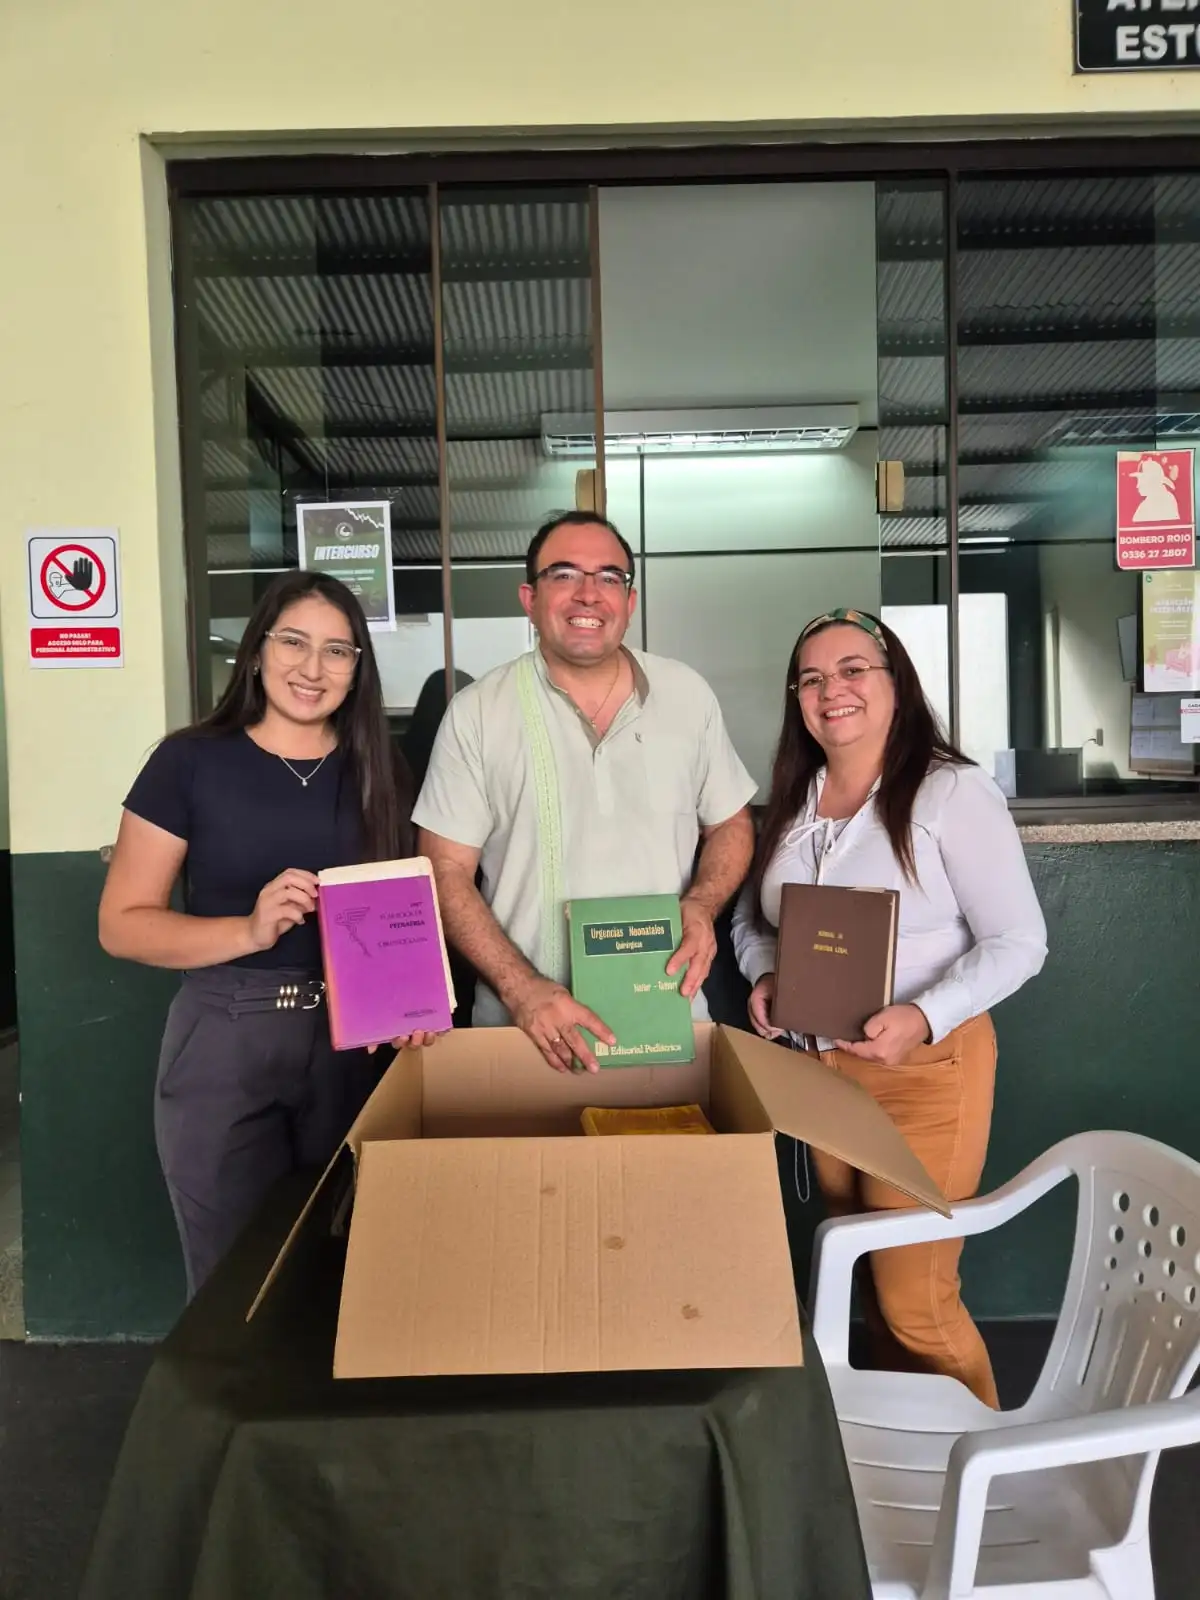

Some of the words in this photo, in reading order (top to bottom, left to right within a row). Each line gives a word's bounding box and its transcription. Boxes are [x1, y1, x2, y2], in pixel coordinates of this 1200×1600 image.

[1116, 24, 1200, 60] EST
[1120, 535, 1165, 544] BOMBERO
[1167, 533, 1191, 543] ROJO
[314, 544, 380, 560] INTERCURSO
[1122, 550, 1145, 559] 0336
[1147, 549, 1159, 558] 27
[1162, 548, 1187, 557] 2807
[590, 927, 624, 940] Urgencias
[629, 924, 665, 936] Neonatales
[610, 1044, 643, 1055] Editorial
